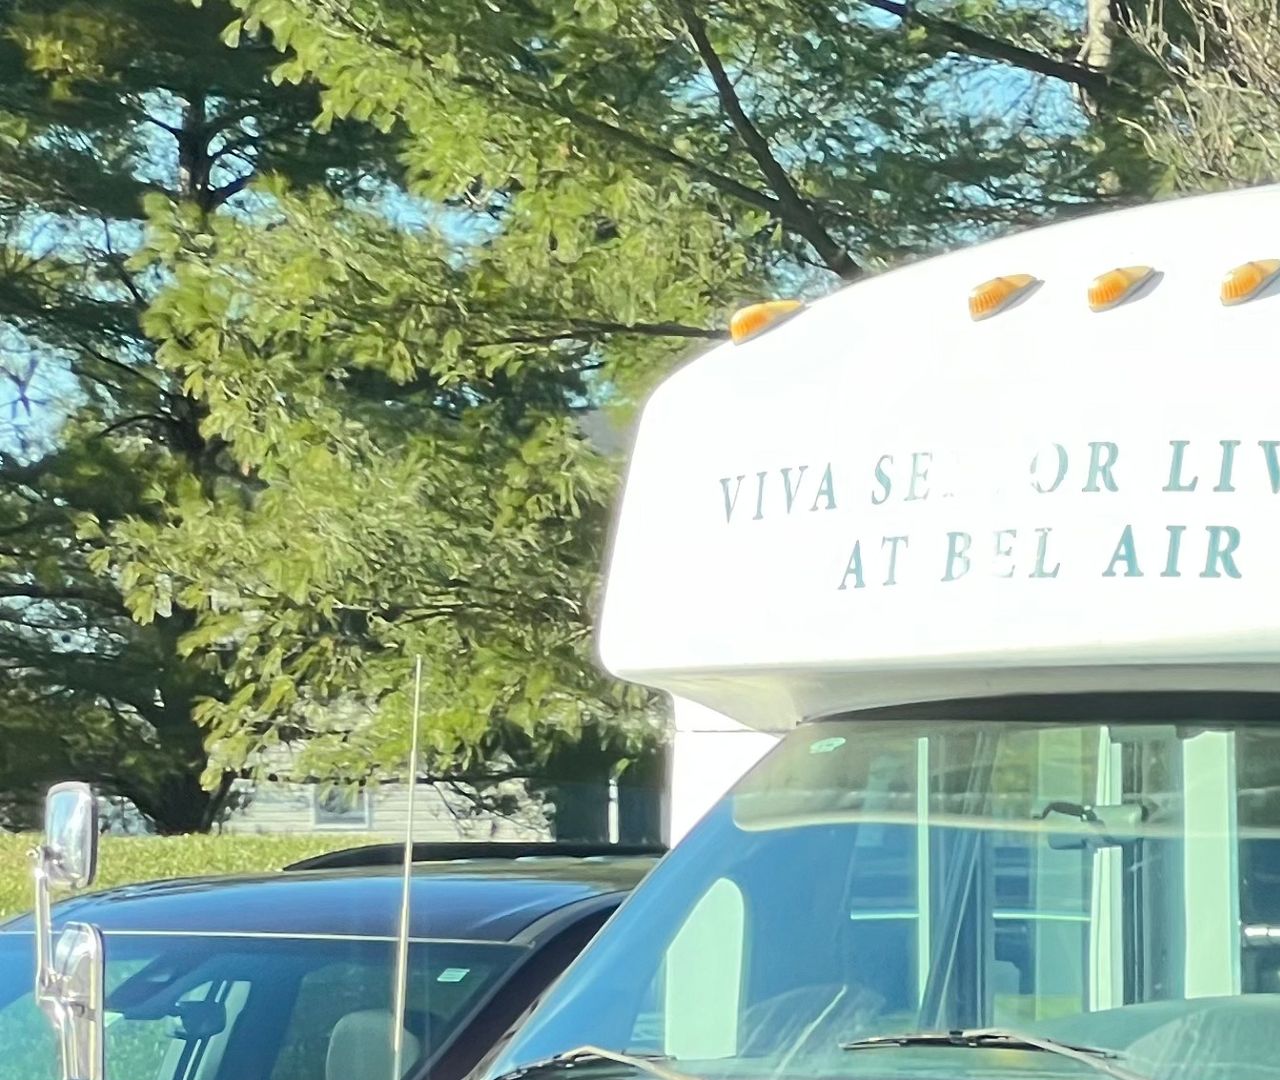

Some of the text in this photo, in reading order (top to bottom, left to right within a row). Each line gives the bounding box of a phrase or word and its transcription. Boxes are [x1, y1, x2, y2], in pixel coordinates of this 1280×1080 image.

[718, 461, 838, 525] VIVA
[870, 440, 1120, 505] SEOR
[836, 523, 1243, 591] AT BEL AIR
